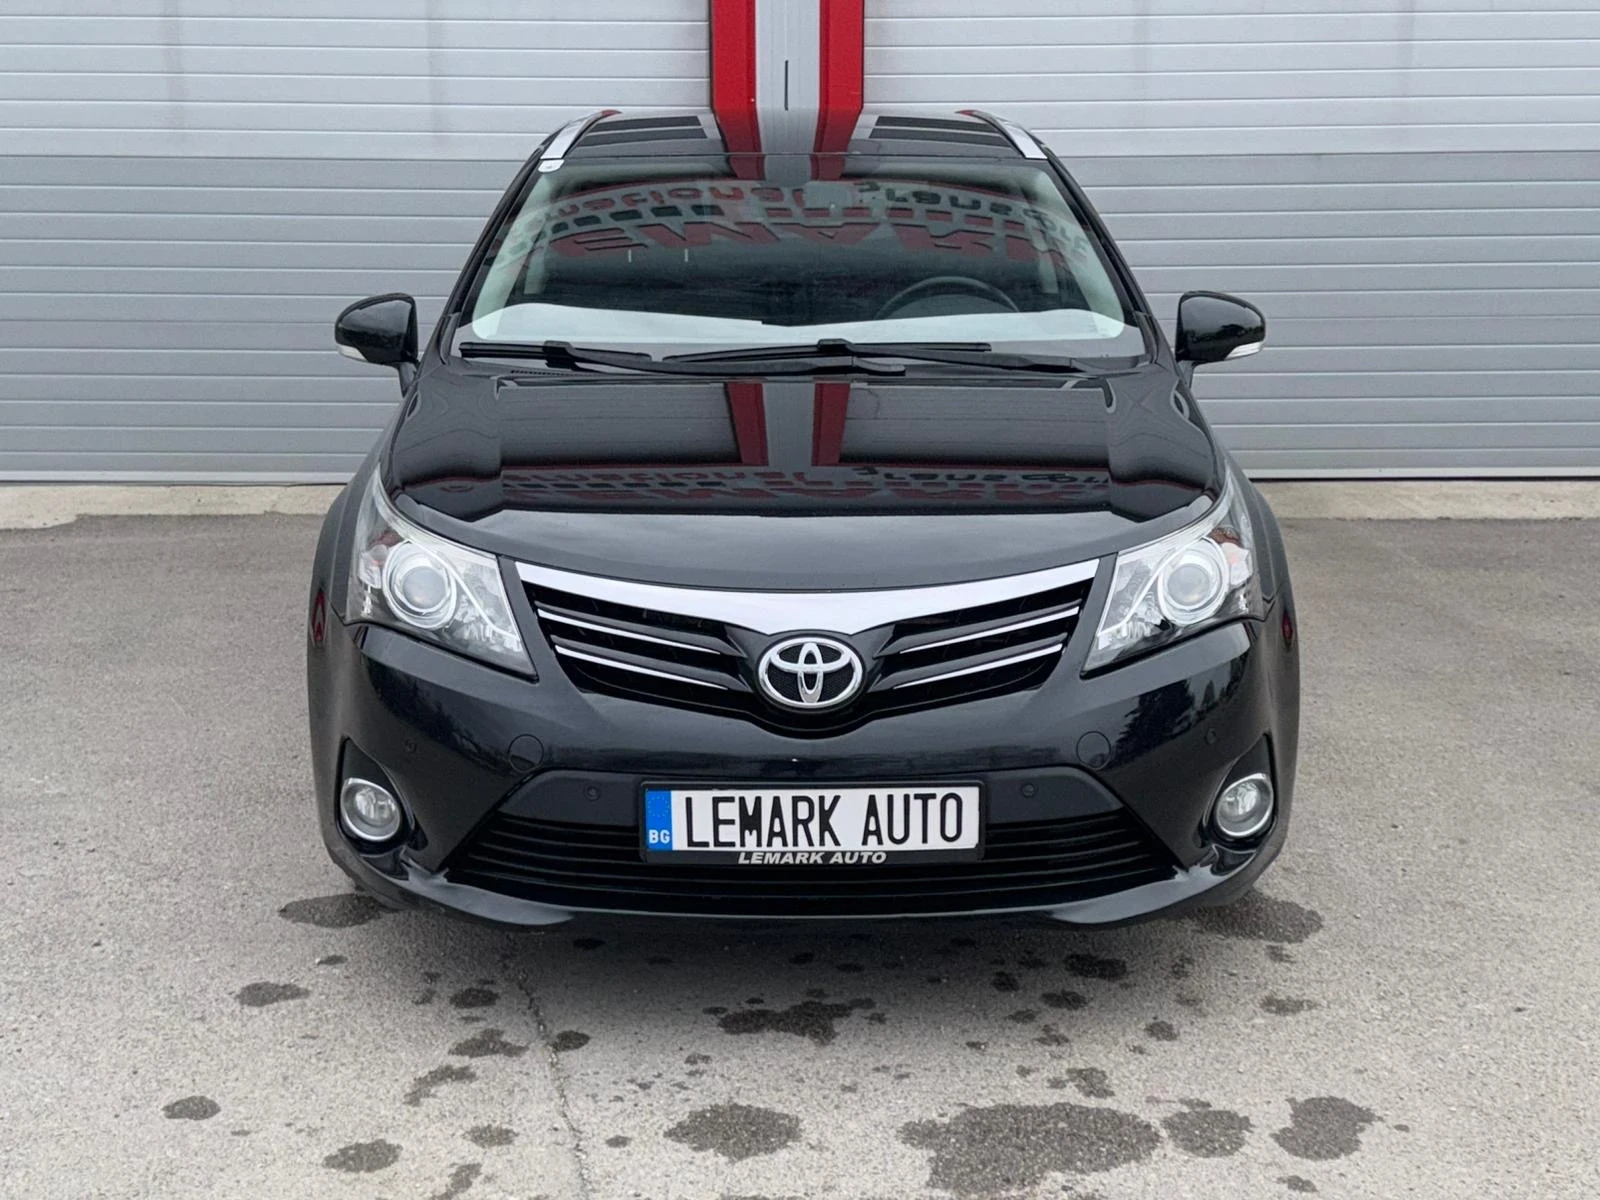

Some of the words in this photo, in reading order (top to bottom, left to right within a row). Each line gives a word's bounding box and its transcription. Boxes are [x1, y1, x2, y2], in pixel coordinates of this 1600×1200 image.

[685, 795, 841, 848] LEMARK
[862, 792, 963, 846] AUTO
[648, 829, 671, 844] BG
[737, 851, 824, 865] LEMARK
[829, 851, 887, 864] AUTO
